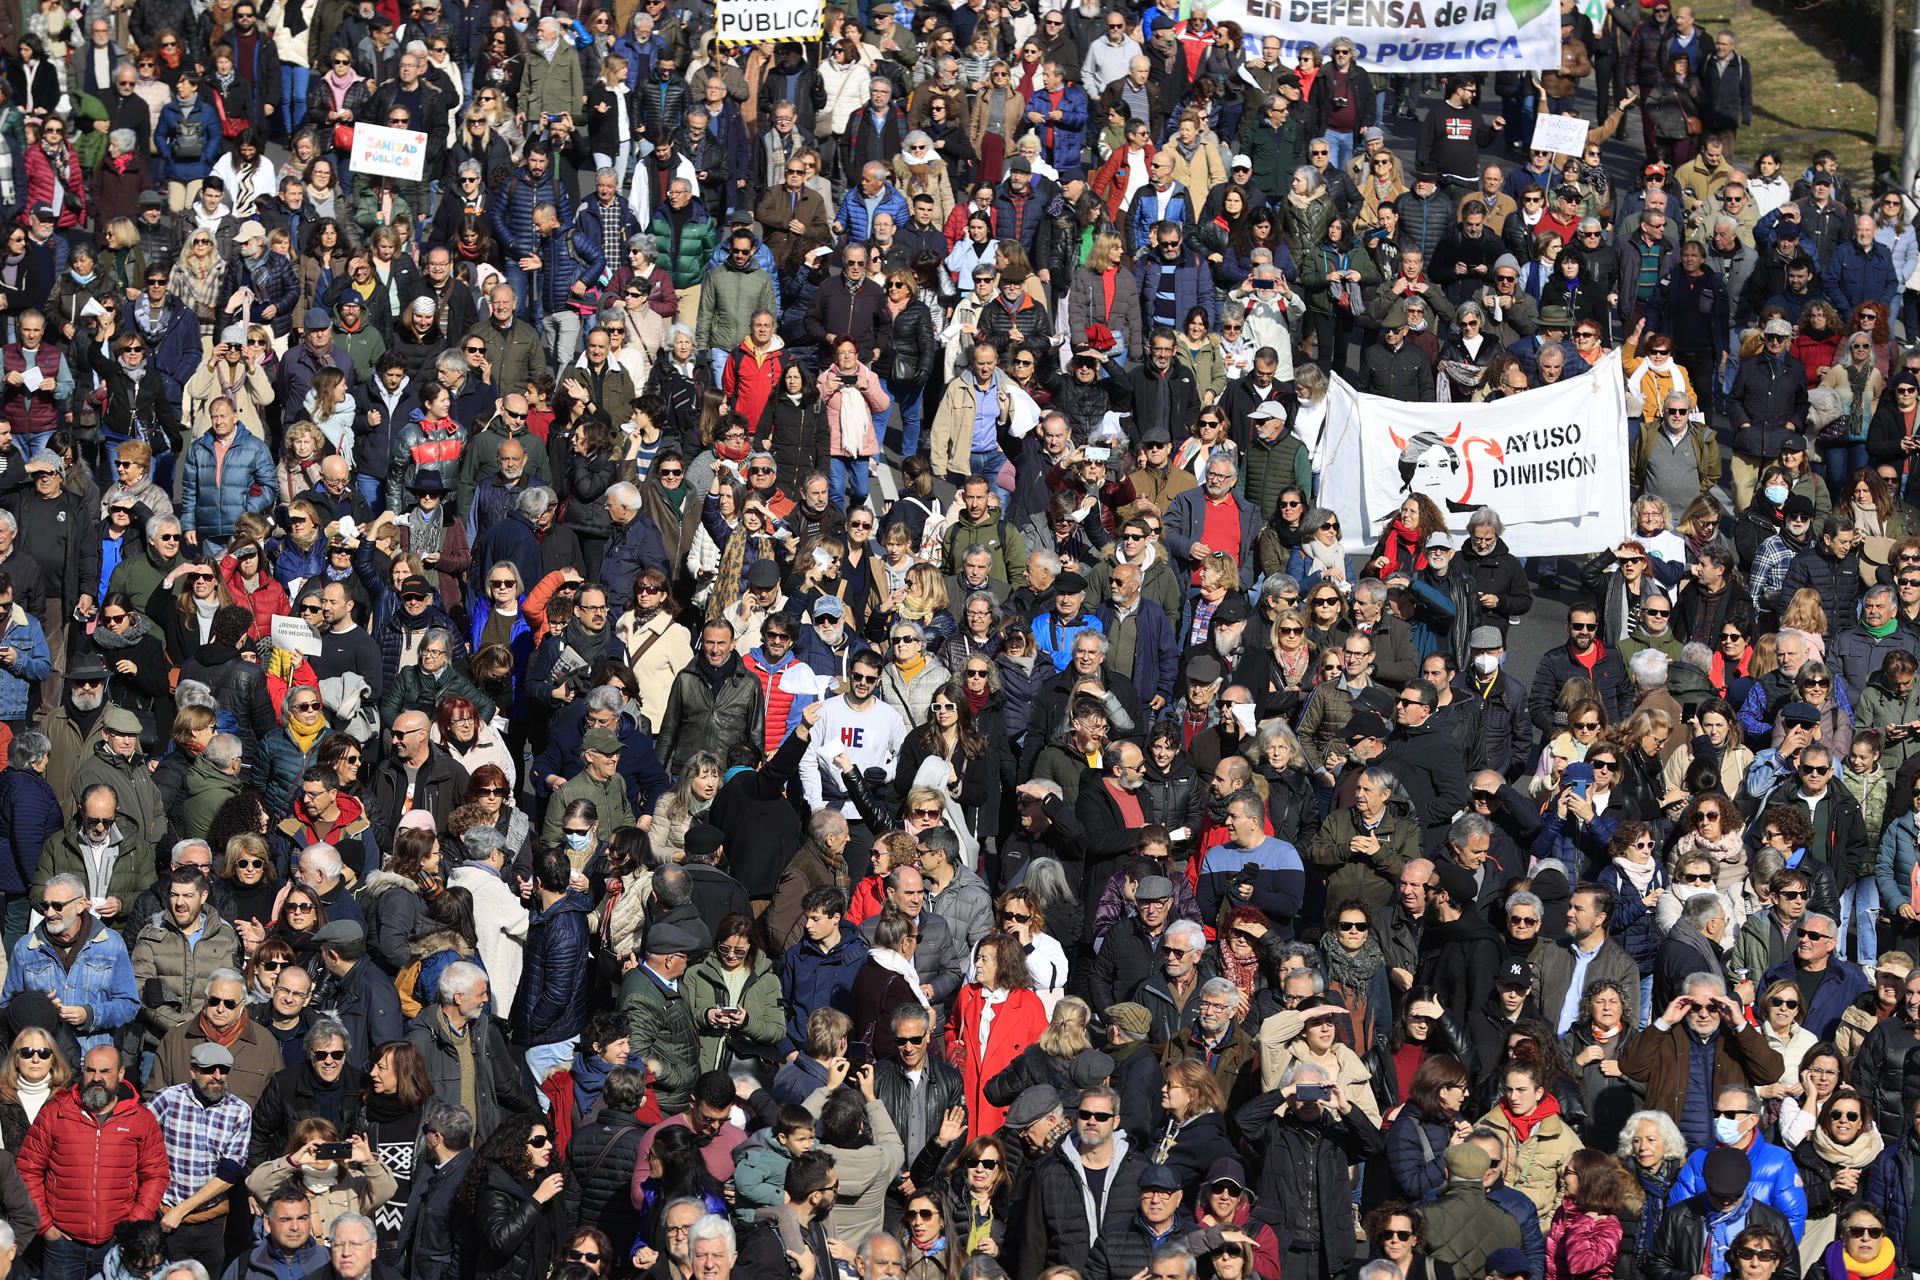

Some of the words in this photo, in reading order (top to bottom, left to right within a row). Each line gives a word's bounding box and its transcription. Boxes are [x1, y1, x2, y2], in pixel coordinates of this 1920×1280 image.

[722, 8, 819, 32] PÚBLICA
[1289, 0, 1426, 28] DEFENSA
[1435, 1, 1467, 28] de
[1474, 0, 1497, 22] la
[1376, 36, 1523, 63] PÚBLICA
[366, 136, 417, 153] SANIDAD
[364, 151, 410, 166] PÚBLICA
[1505, 423, 1582, 455] AYUSO
[1493, 452, 1597, 488] DIMISIÓN
